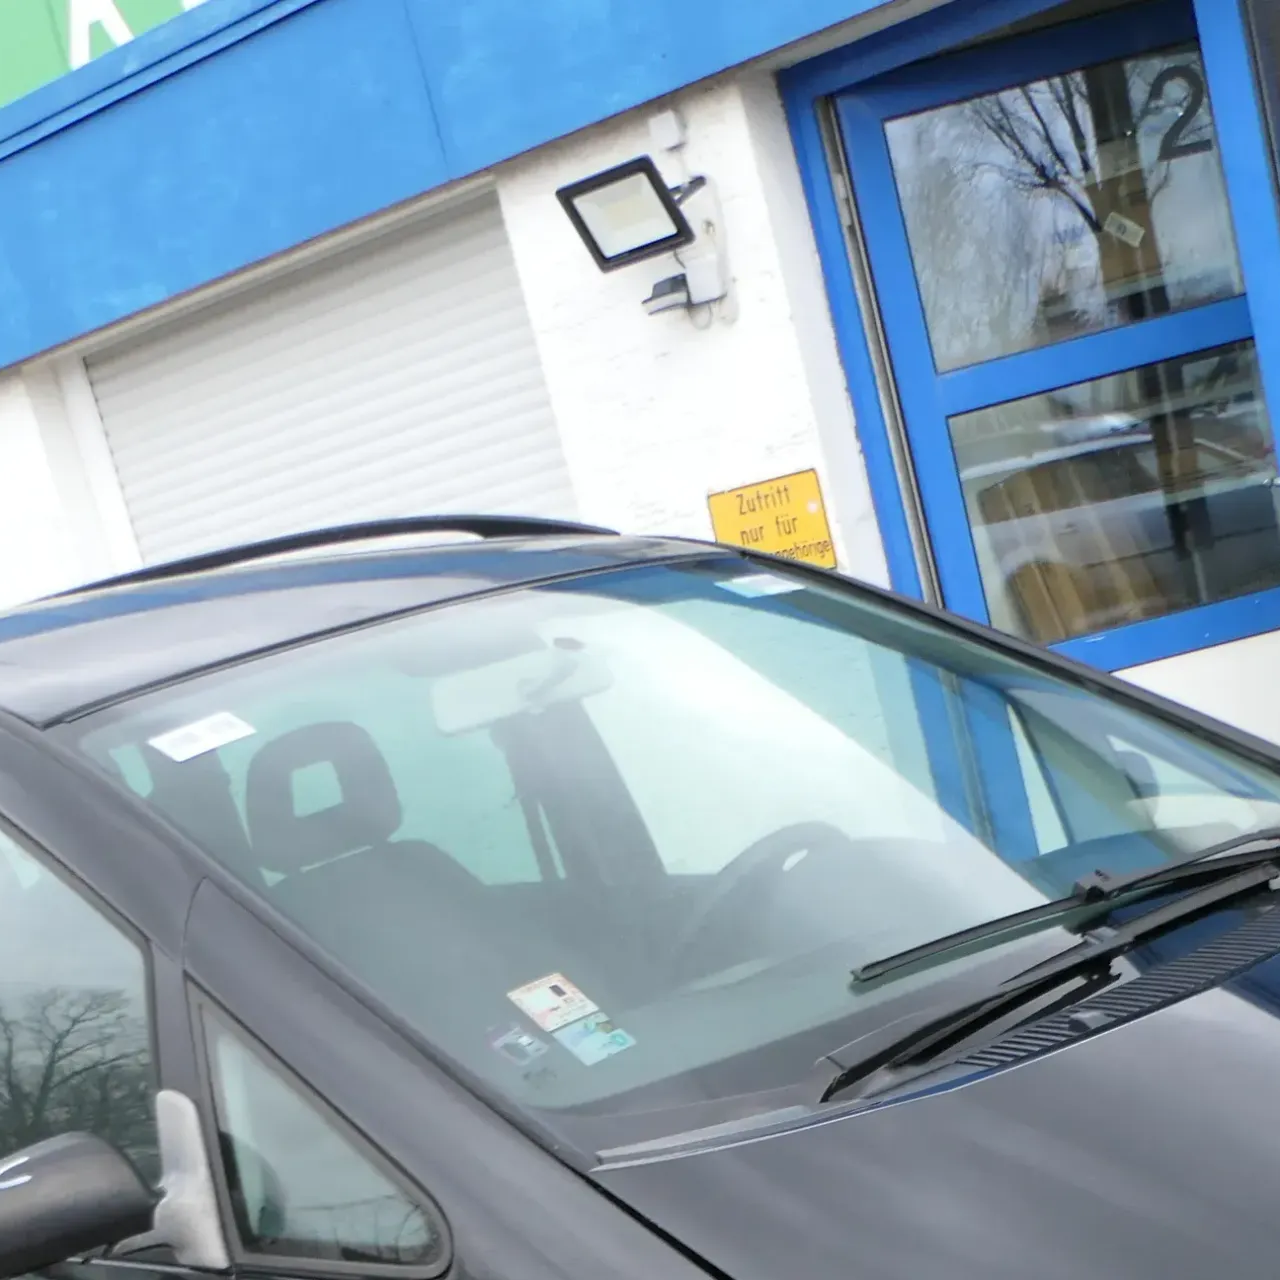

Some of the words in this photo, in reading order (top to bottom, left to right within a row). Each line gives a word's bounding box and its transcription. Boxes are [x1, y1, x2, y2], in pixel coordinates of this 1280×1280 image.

[1147, 65, 1213, 162] 2
[735, 484, 791, 516] Zutritt
[739, 525, 765, 546] nur
[775, 513, 798, 537] für
